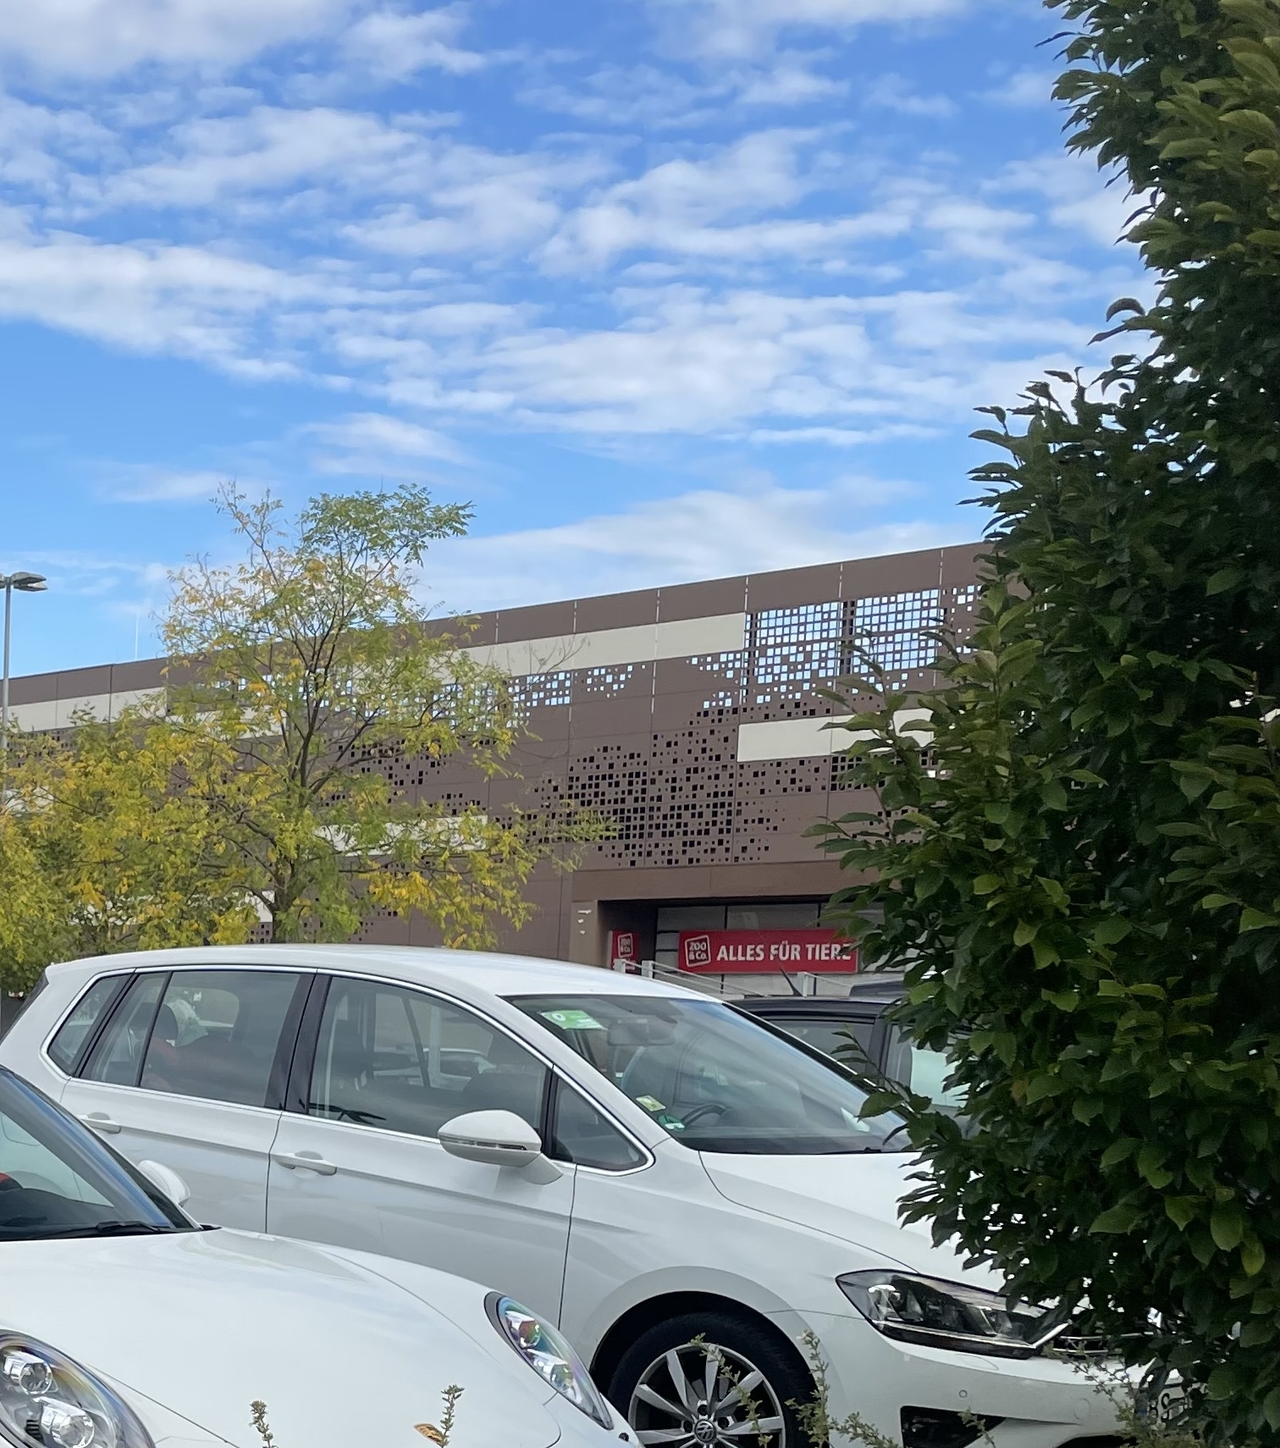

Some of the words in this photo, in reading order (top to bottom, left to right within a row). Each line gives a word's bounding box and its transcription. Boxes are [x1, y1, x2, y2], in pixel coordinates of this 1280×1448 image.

[689, 942, 707, 951] ZOO
[717, 944, 765, 961] ALLES
[770, 940, 801, 960] FÜR
